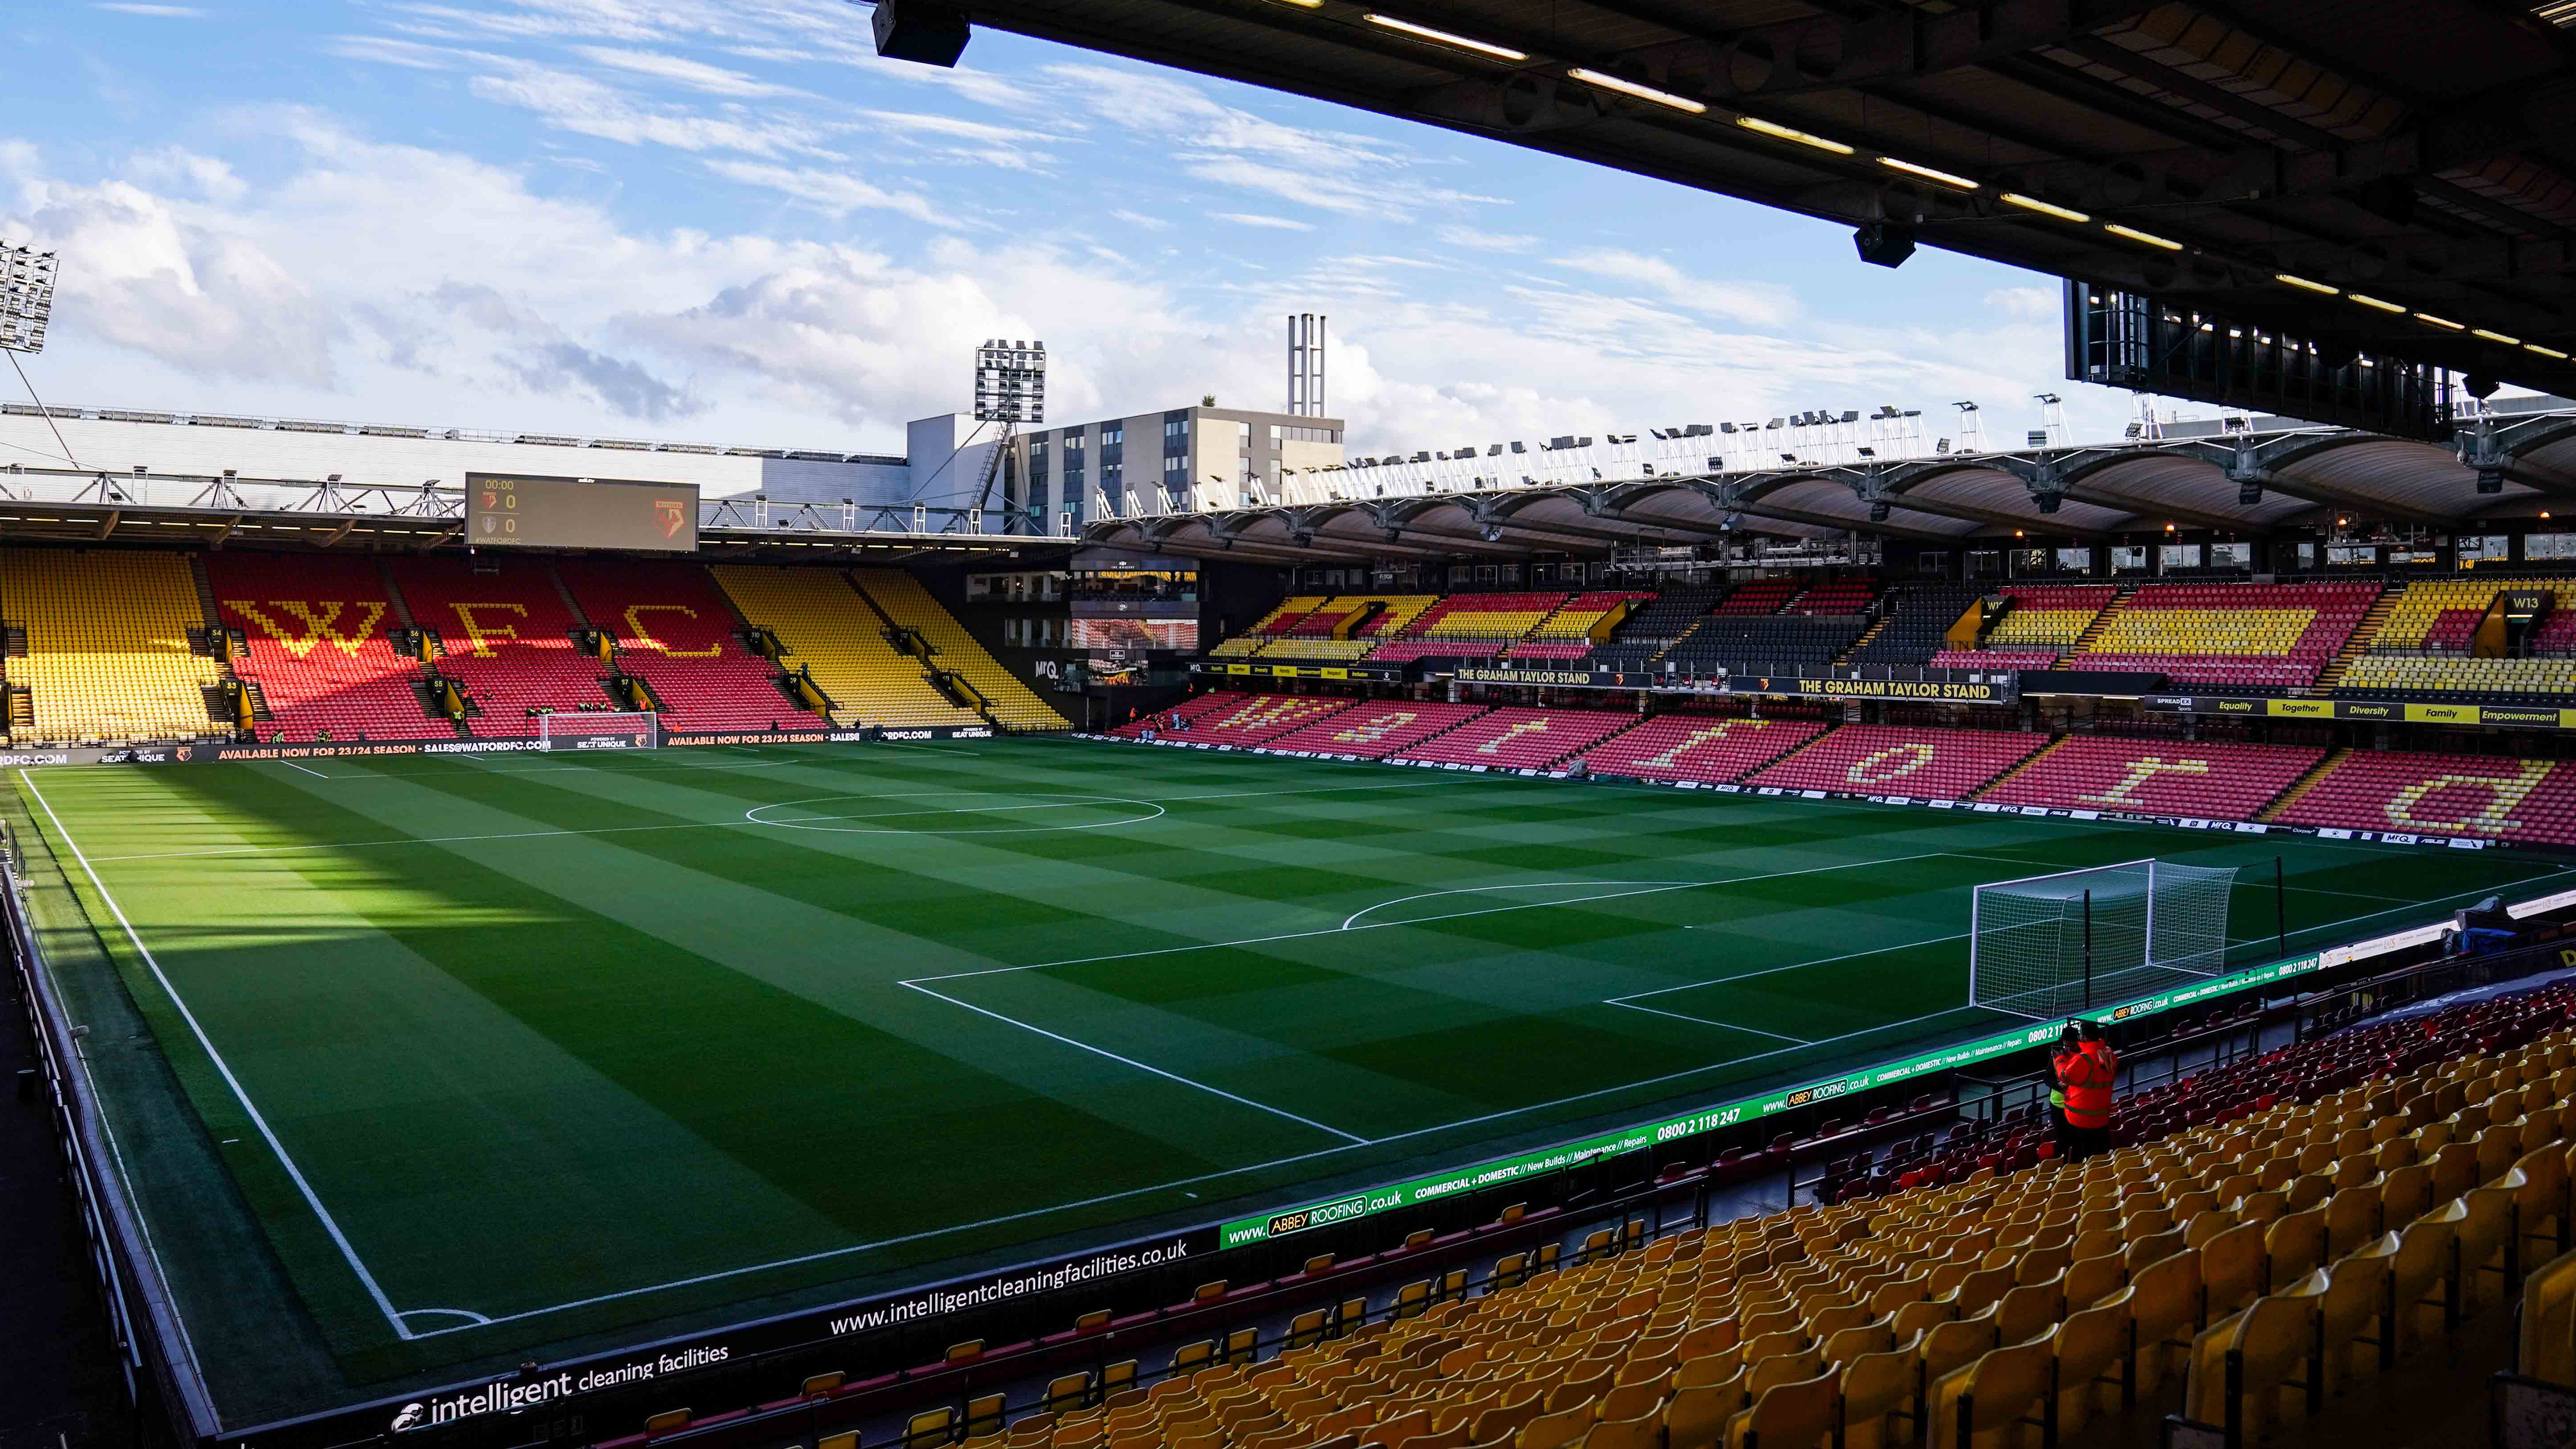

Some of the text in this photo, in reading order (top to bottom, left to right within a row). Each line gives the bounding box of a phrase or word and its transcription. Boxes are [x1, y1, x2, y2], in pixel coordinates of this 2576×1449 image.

[485, 480, 514, 490] 00:00
[506, 494, 516, 509] 0
[505, 518, 516, 533] 0
[475, 537, 522, 545] #WATFORDFC
[2513, 597, 2539, 608] W13
[1035, 660, 1059, 680] MrQ
[1458, 669, 1590, 685] THE GRAHAM TAYLOR STAND
[1799, 679, 1990, 699] THE GRAHAM TAYLOR STAND
[2219, 701, 2253, 711] Equality
[2281, 703, 2320, 713] Together
[2349, 705, 2390, 717] Diversity
[2425, 708, 2458, 719] Family
[2482, 710, 2556, 722] Empowerment
[597, 740, 626, 748] UNIQUE
[668, 736, 715, 746] AVAILABLE
[717, 736, 740, 744] NOW
[742, 735, 759, 744] FOR
[762, 734, 788, 743] 23/24
[790, 733, 823, 742] SEASON
[218, 749, 279, 759] AVAILABLE
[282, 748, 311, 758] NOW
[313, 747, 335, 756] FOR
[338, 746, 371, 756] 23/24
[373, 745, 416, 755] SEASON
[424, 740, 551, 753] SALES@WATFORDFC.COM
[101, 755, 127, 763] SEAT
[2211, 821, 2232, 830] MrQ
[2387, 834, 2410, 843] MrQ
[2279, 965, 2292, 976] 0800
[2292, 964, 2297, 973] 2
[2297, 960, 2307, 972] 118
[2307, 958, 2317, 969] 247
[2097, 997, 2169, 1024] www. ABBEY ROOFING .co.uk
[2028, 1030, 2047, 1043] 0800
[2048, 1026, 2053, 1038] 2
[1876, 1067, 1910, 1082] COMMERCIAL
[1915, 1058, 1941, 1072] DOMESTIC
[1946, 1053, 1957, 1064] New
[1957, 1049, 1970, 1062] Builds
[1975, 1044, 2003, 1056] Maintenance
[2007, 1038, 2022, 1048] Repairs
[1763, 1075, 1869, 1113] www. ABBEY ROOFING .co.uk
[1657, 1108, 1741, 1141] 0800 2 118 247
[1415, 1177, 1470, 1199] COMMERCIAL
[1477, 1165, 1519, 1184] DOMESTIC
[1527, 1161, 1544, 1172] New
[1545, 1154, 1566, 1169] Builds
[1574, 1143, 1616, 1161] Maintenance
[1623, 1134, 1647, 1148] Repairs
[1229, 1190, 1402, 1244] www. ABBEY ROOFING .co.uk
[830, 1239, 1187, 1335] www.intelligentcleaningfacilities.co.uk
[432, 1346, 728, 1424] intelligent cleaning facilities
